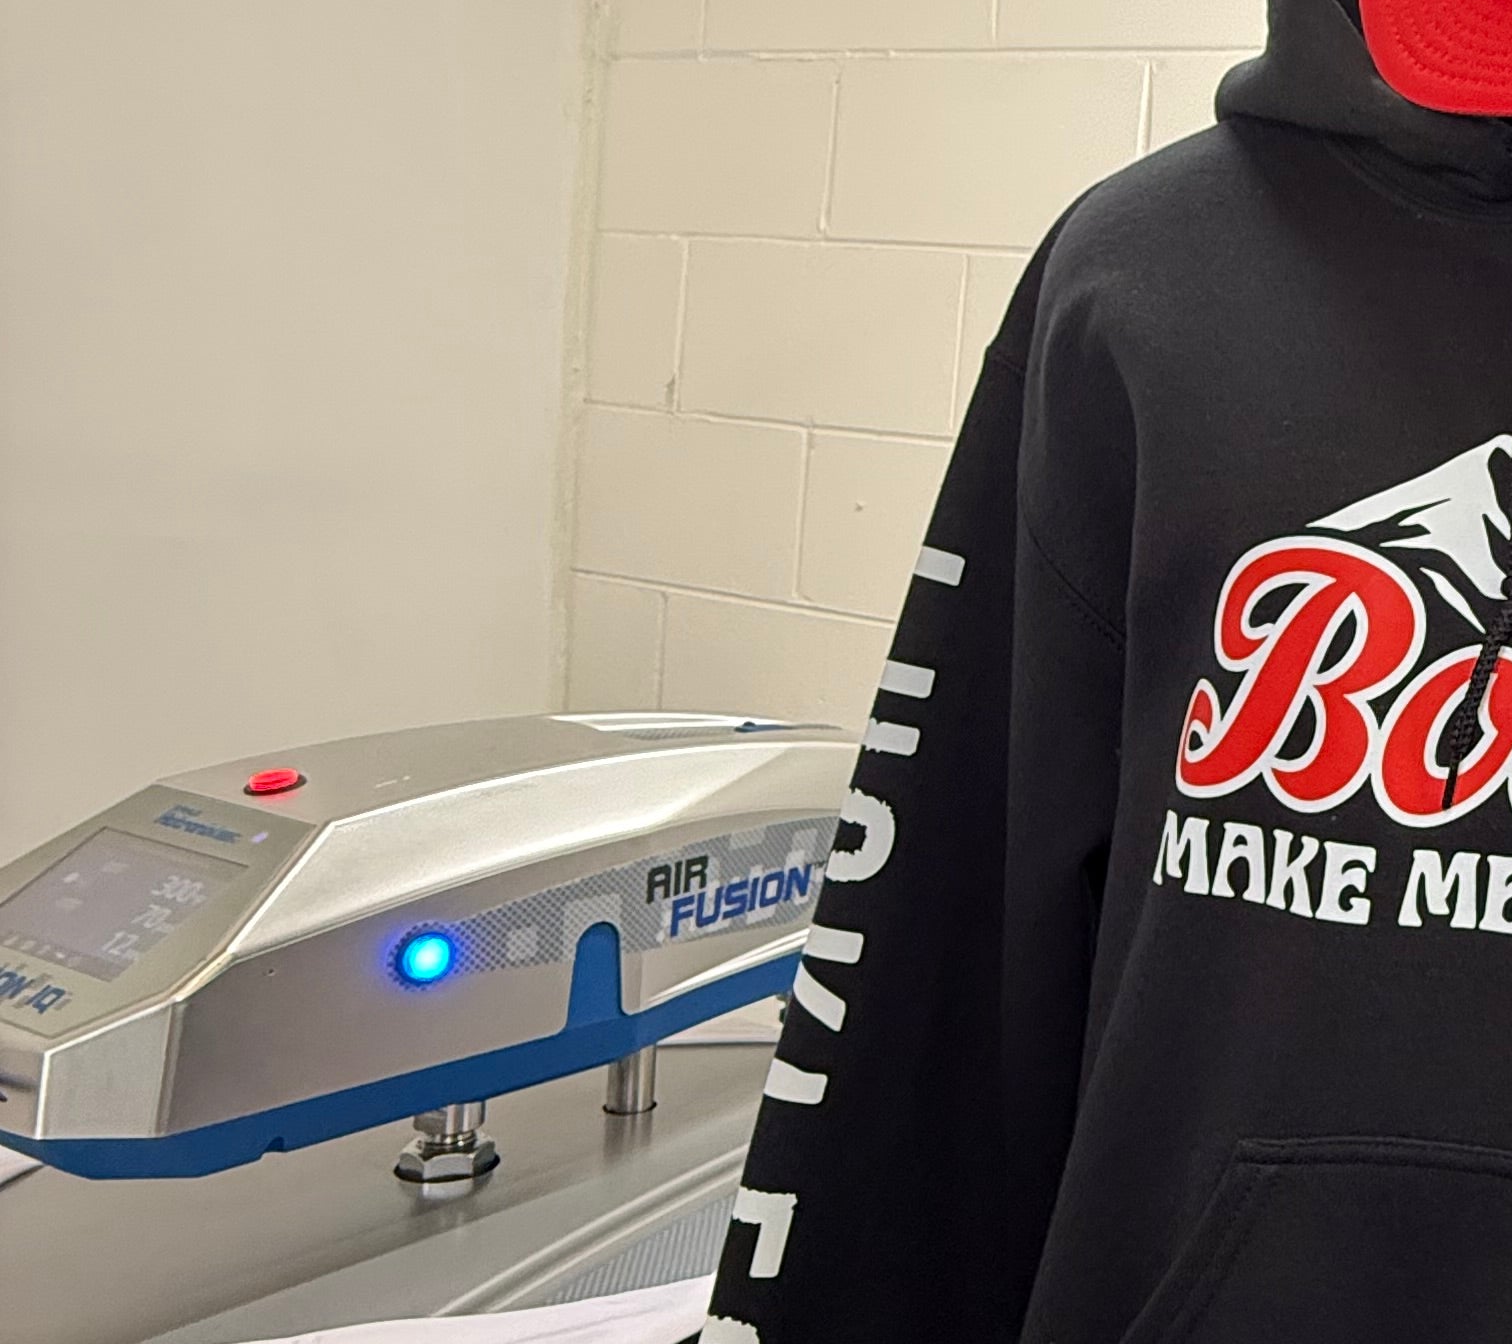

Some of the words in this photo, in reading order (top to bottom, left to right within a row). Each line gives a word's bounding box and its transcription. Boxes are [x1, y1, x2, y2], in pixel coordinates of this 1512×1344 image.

[646, 855, 709, 905] AIR
[670, 863, 813, 938] FUSION
[1153, 809, 1377, 926] MAKE
